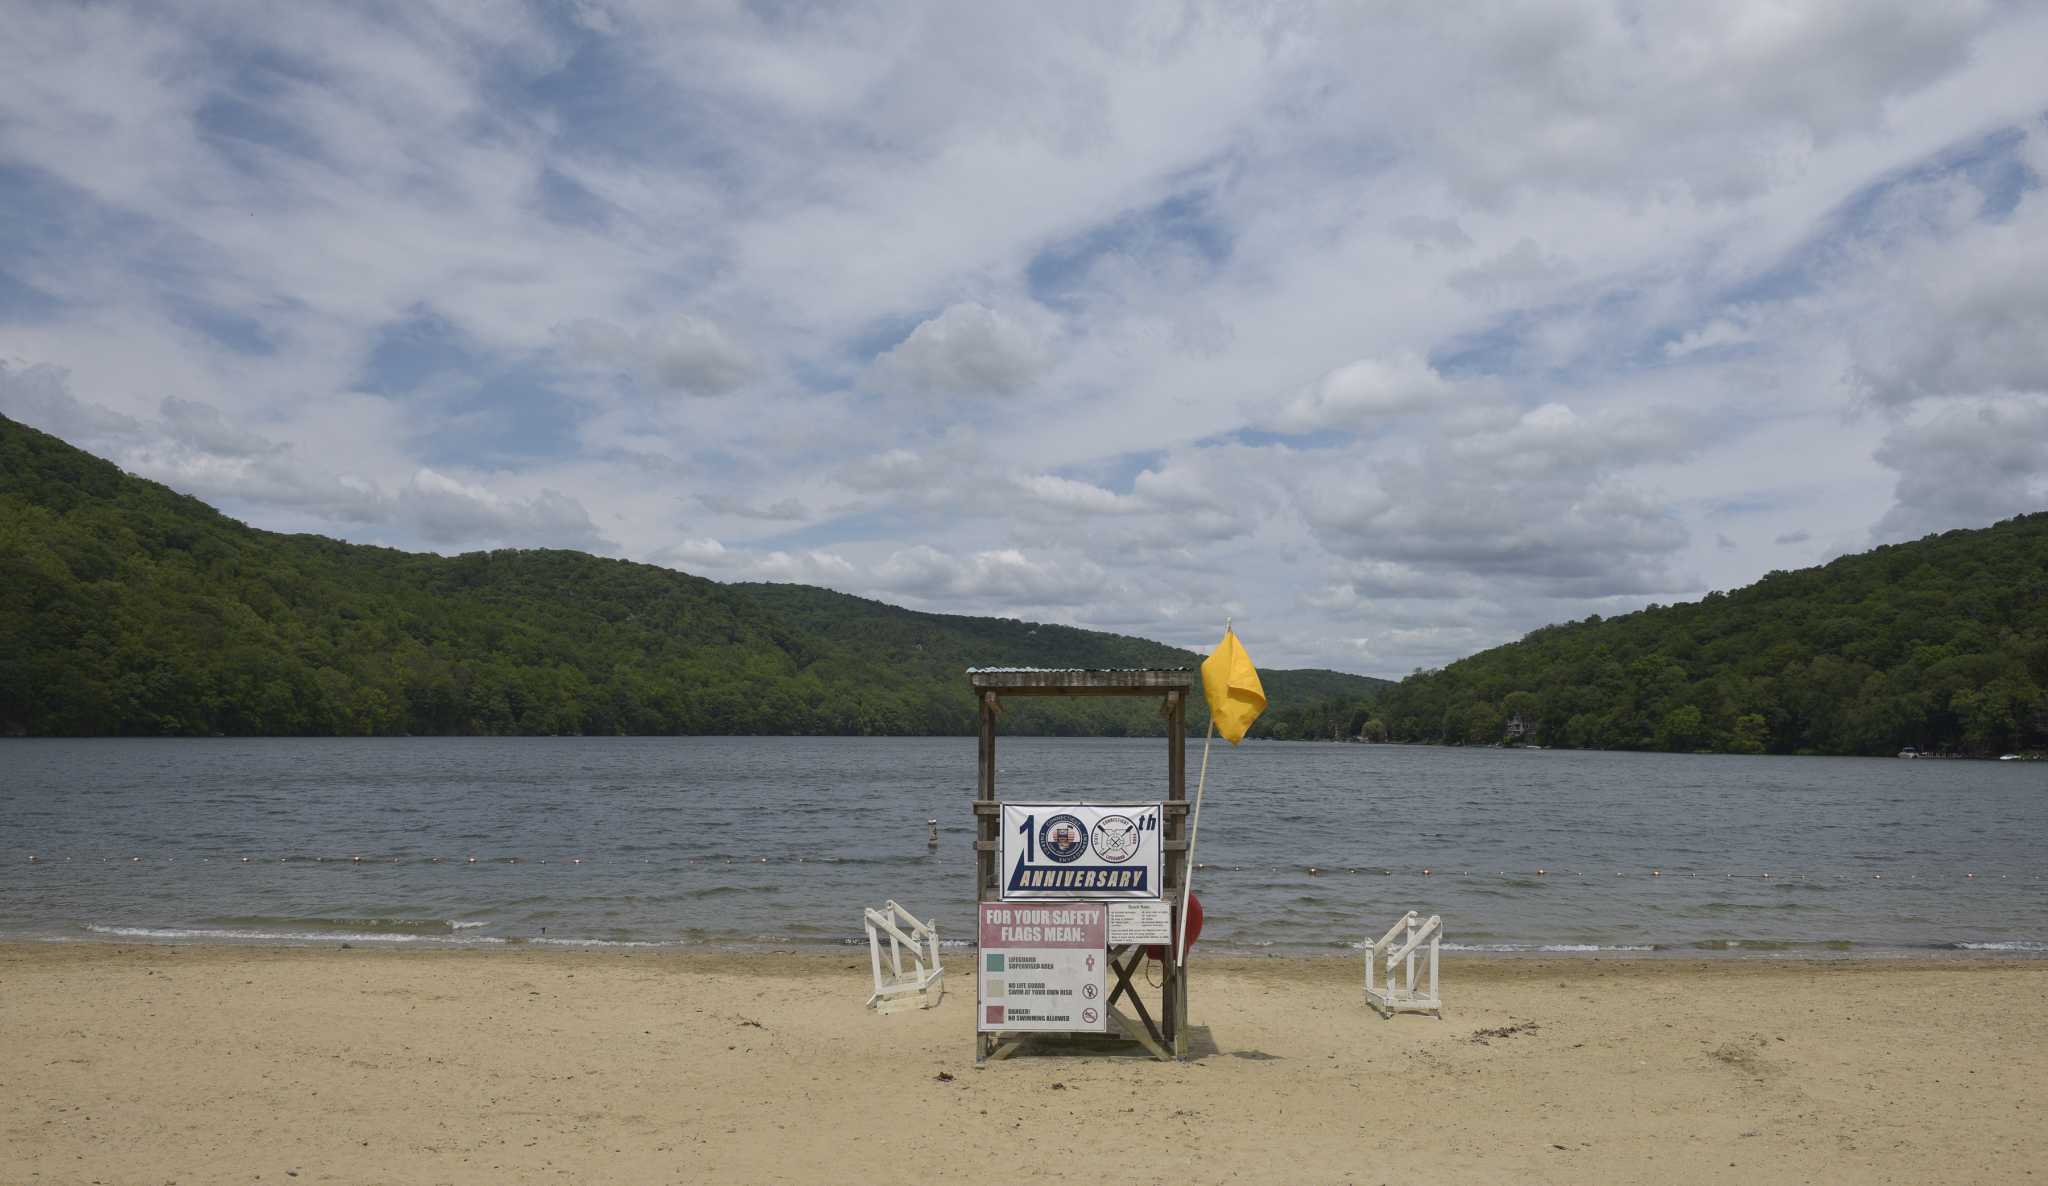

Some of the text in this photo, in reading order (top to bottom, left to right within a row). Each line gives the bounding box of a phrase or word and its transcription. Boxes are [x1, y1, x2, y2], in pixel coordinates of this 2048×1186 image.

[1019, 870, 1143, 887] ANNIVERSARY
[986, 909, 1011, 925] FOR
[1014, 909, 1051, 925] YOUR
[1053, 910, 1100, 925] SAFETY
[1001, 926, 1085, 943] FLAGS MEAN:
